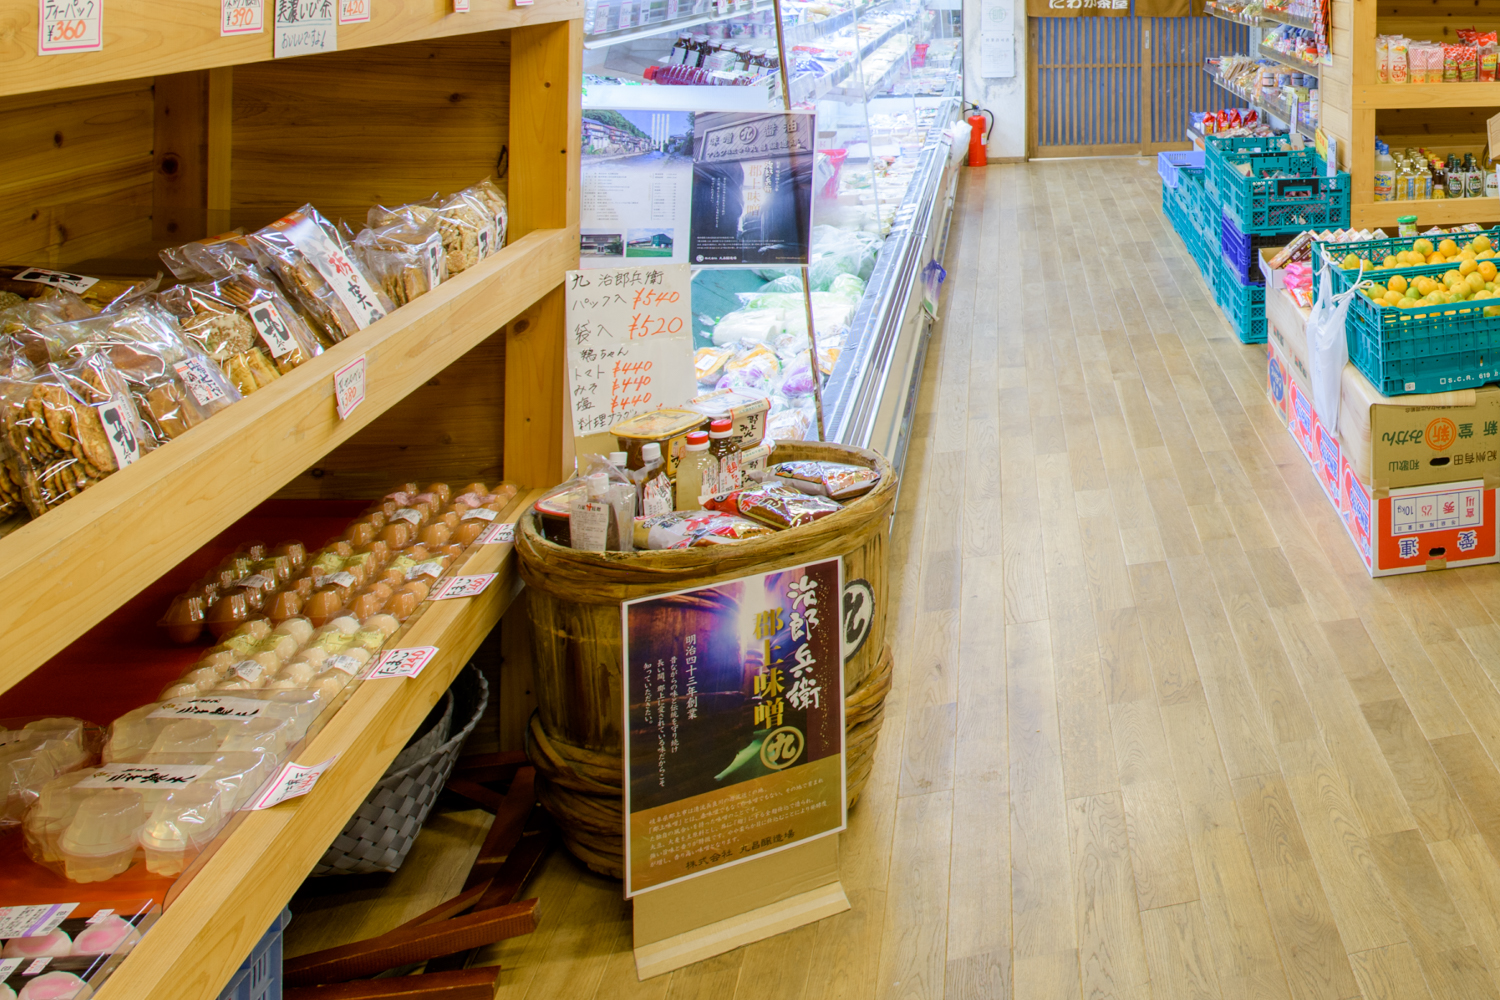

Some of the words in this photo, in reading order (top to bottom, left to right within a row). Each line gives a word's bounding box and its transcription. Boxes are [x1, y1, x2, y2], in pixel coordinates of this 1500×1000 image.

[226, 7, 254, 28] ¥390
[343, 0, 365, 17] ¥420
[46, 19, 87, 42] ¥360
[597, 269, 665, 289] 治郎兵衛
[632, 287, 680, 310] ¥540
[628, 312, 684, 340] ¥520
[574, 364, 606, 381] トマト
[612, 360, 653, 378] ¥440
[573, 382, 598, 396] みそ
[611, 376, 652, 396] ¥440
[610, 392, 652, 413] ¥440
[1381, 428, 1424, 446] みかん
[1388, 458, 1421, 473] 和歌山
[1453, 450, 1498, 466] 紀州有田
[1397, 504, 1414, 516] 10kg
[1442, 500, 1456, 515] 秀
[785, 574, 822, 712] 治郎兵衛
[684, 633, 699, 721] 明治四十三年創業
[751, 605, 786, 730] 郡上味噌
[669, 654, 680, 754] 昔ながらの味と伝統を守り続け
[684, 849, 734, 871] 株式会社
